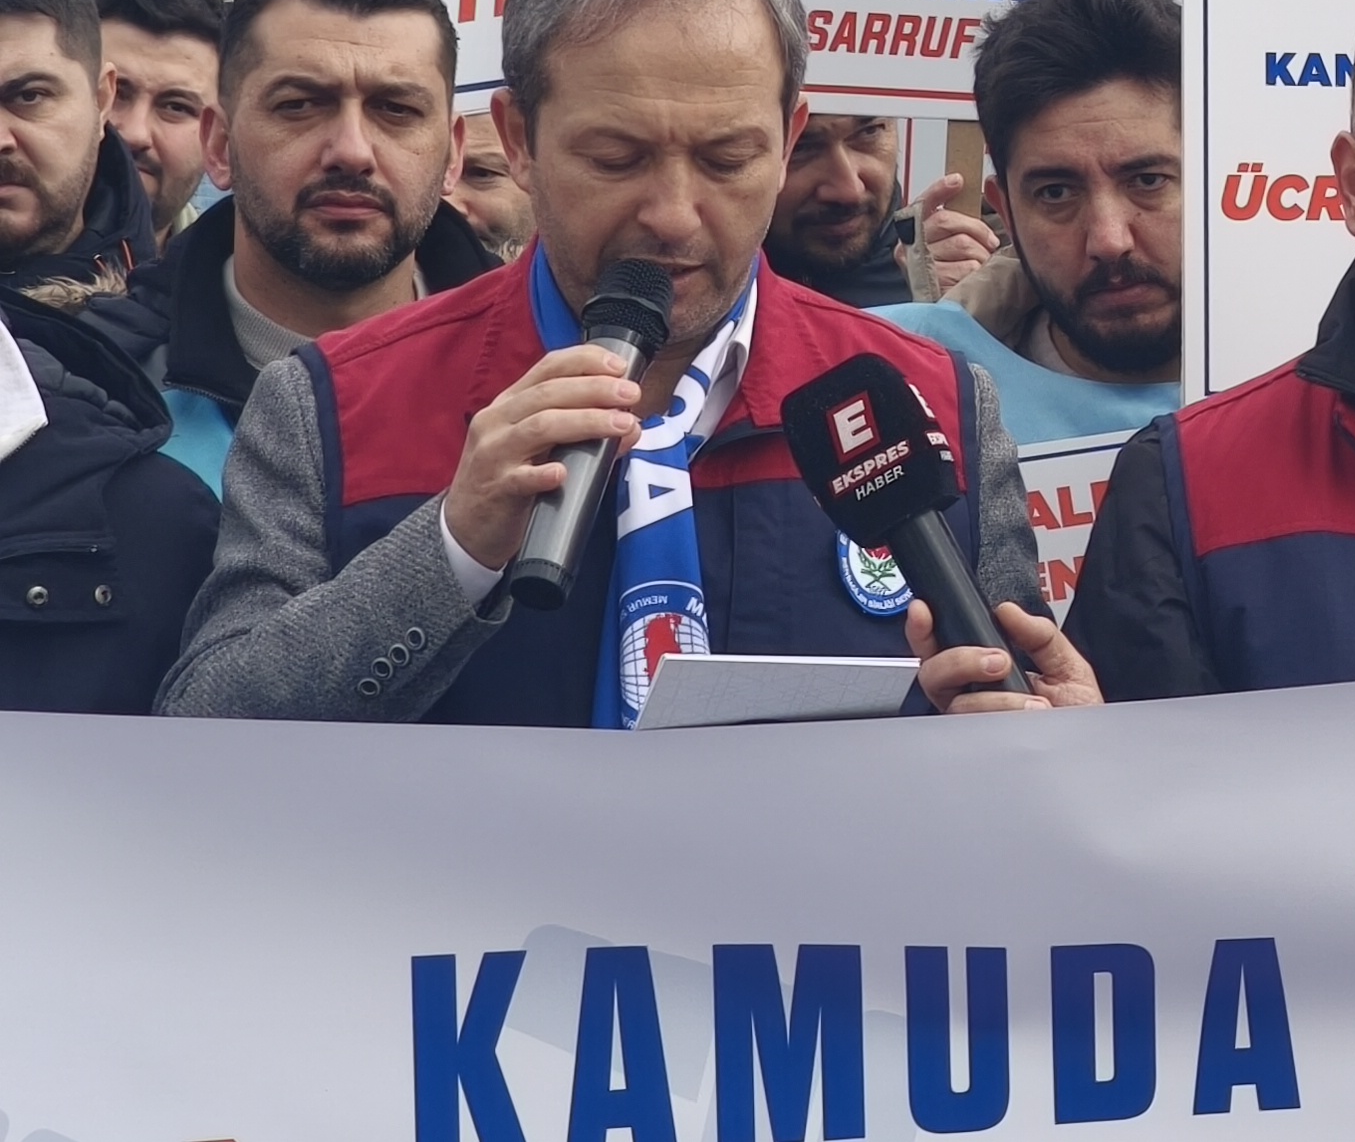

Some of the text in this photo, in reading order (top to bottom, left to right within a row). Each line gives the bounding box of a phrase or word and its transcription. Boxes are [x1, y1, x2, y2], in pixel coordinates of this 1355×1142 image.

[806, 9, 983, 60] SARRUF
[1221, 162, 1345, 221] ÜCR
[833, 399, 874, 454] E
[832, 440, 910, 494] EKSPRES
[855, 465, 906, 501] HABER
[411, 937, 1301, 1142] KAMUDA
